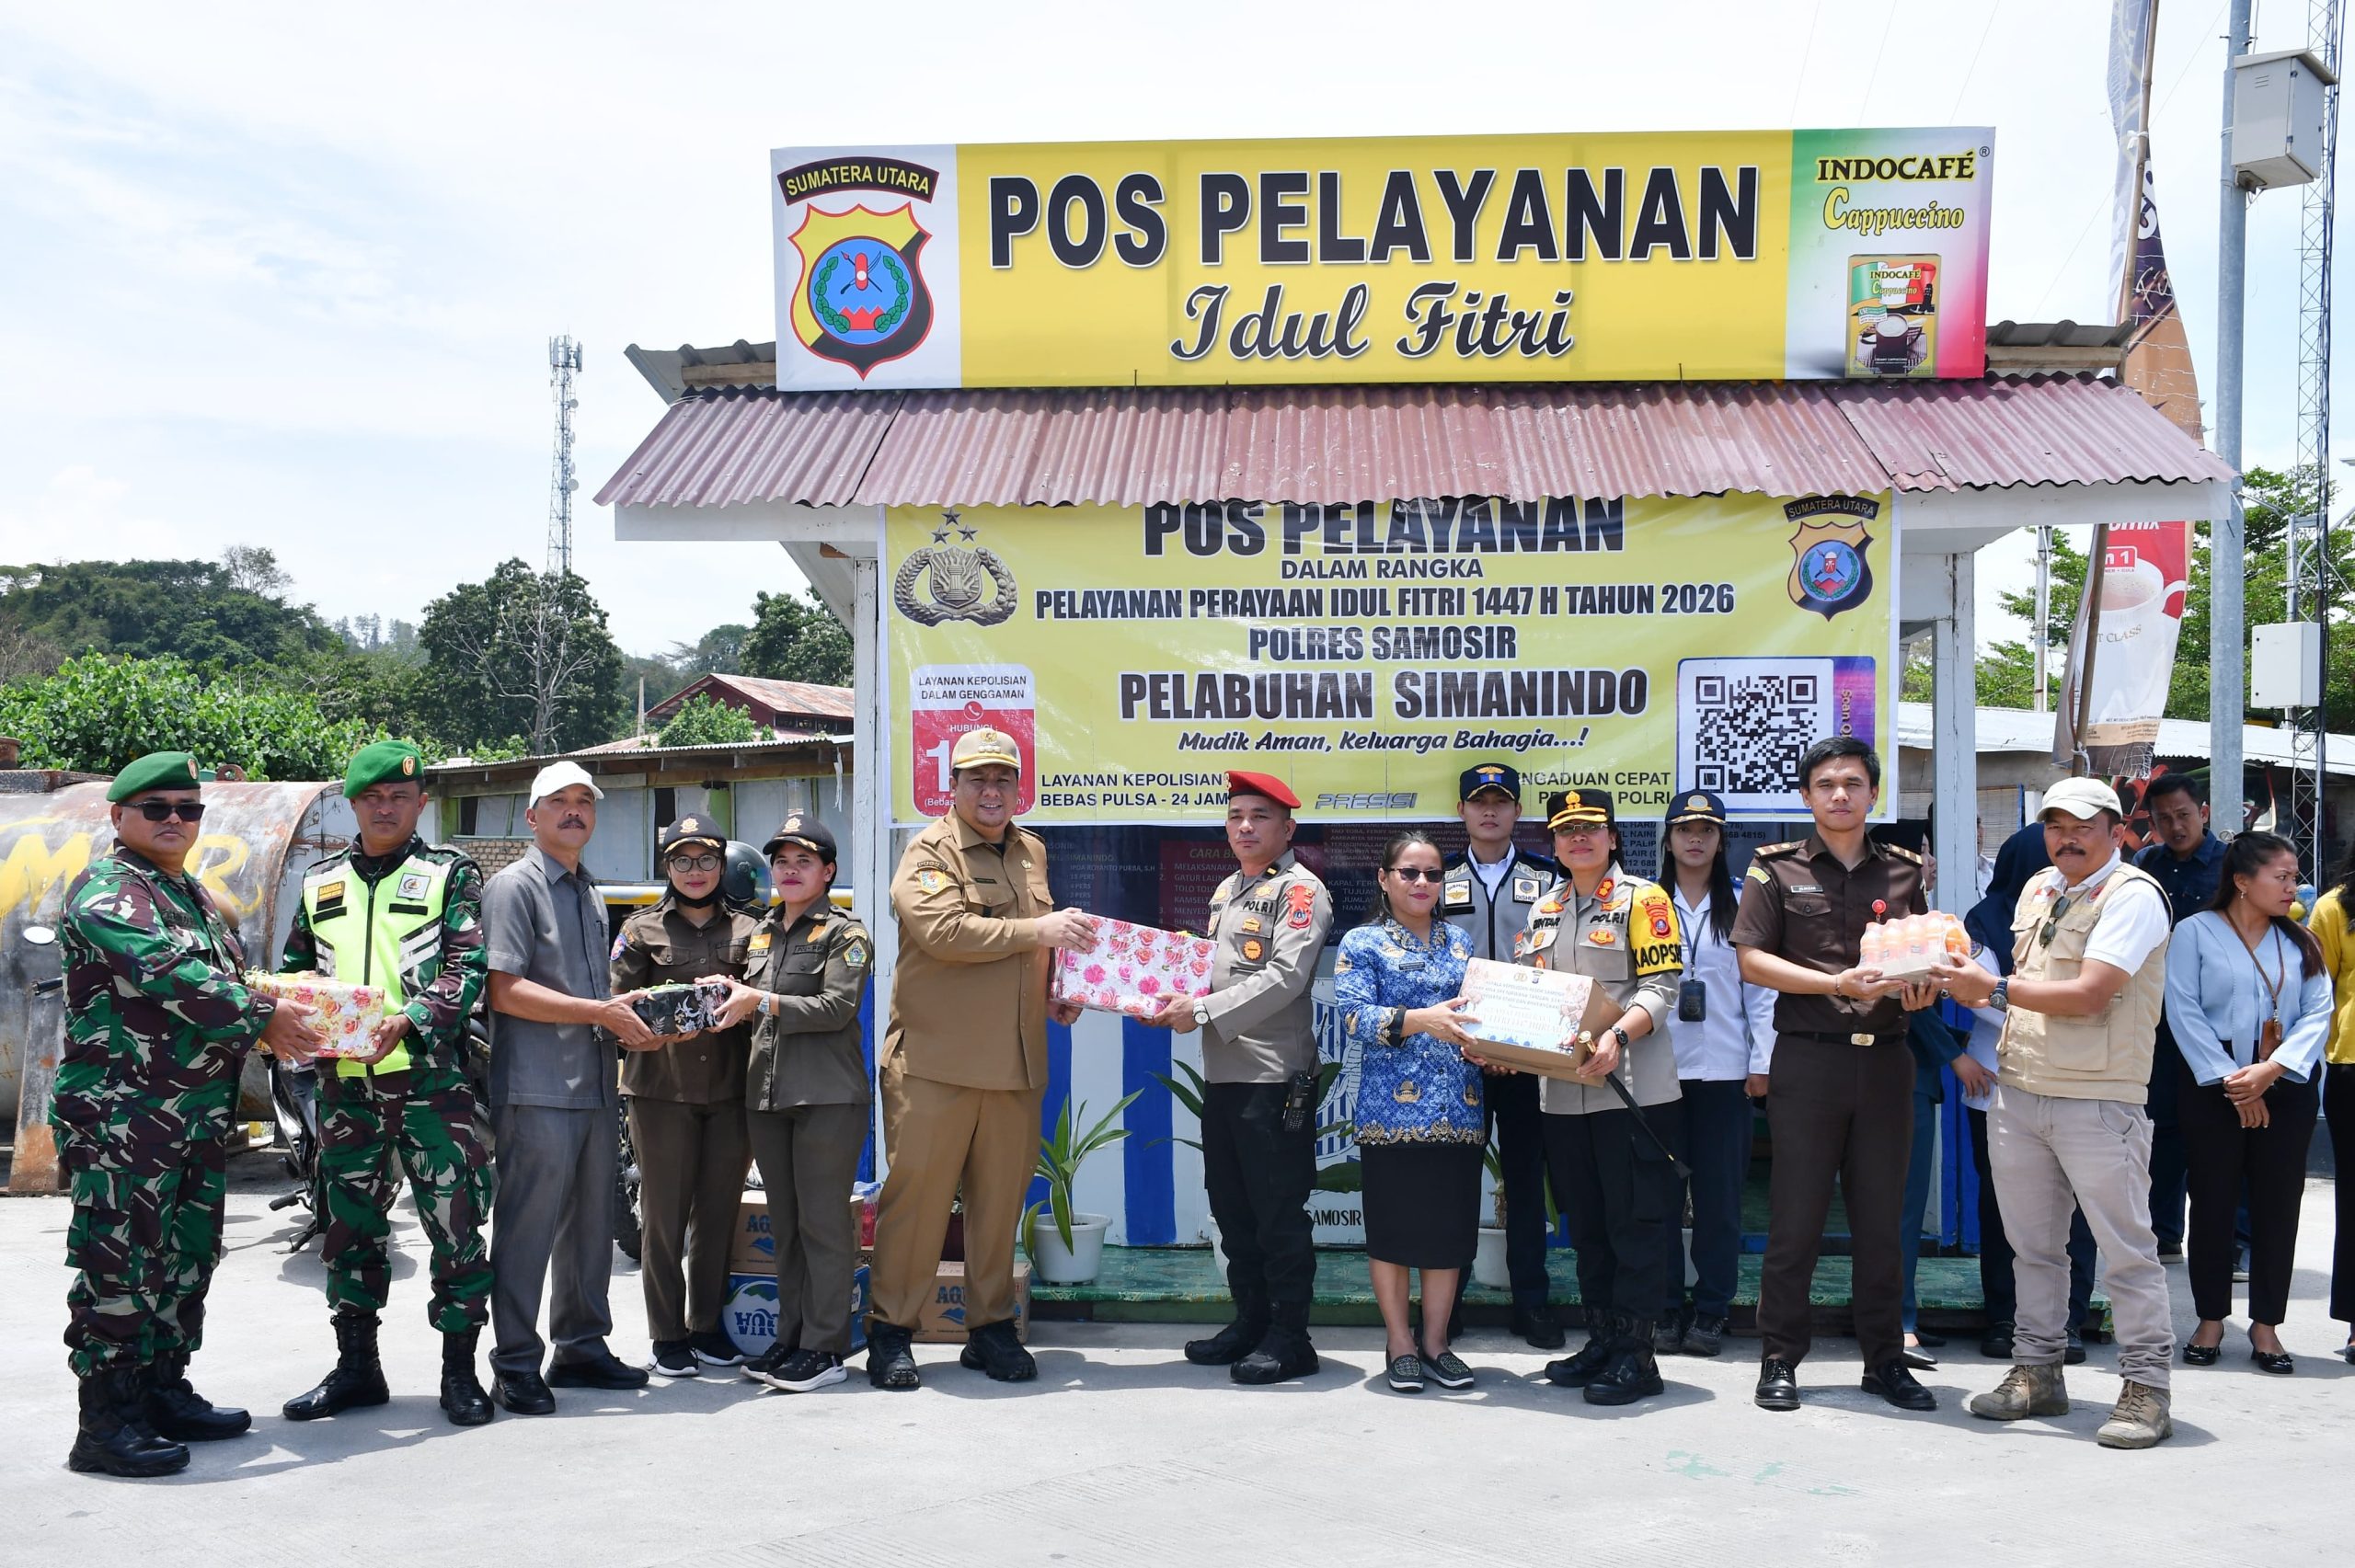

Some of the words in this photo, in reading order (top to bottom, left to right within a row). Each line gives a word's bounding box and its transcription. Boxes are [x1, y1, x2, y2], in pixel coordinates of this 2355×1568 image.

[1816, 151, 1975, 181] INDOCAFÉ
[786, 165, 874, 197] SUMATERA
[877, 166, 931, 195] UTARA
[988, 171, 1168, 269] POS
[1199, 166, 1759, 266] PELAYANAN
[1822, 187, 1965, 237] Cappuccino
[1170, 283, 1370, 361] Idul
[1395, 280, 1574, 360] Fitri
[1787, 498, 1841, 519] SUMATERA
[1843, 499, 1875, 517] UTARA
[1143, 499, 1267, 557] POS
[1281, 497, 1625, 555] PELAYANAN
[1281, 558, 1368, 580] DALAM
[1375, 557, 1484, 579] RANGKA
[1035, 589, 1184, 621] PELAYANAN
[1189, 587, 1325, 619] PERAYAAN
[1329, 586, 1394, 618] IDUL
[1397, 585, 1466, 618] FITRI
[1471, 584, 1534, 617] 1447
[1539, 584, 1560, 616] H
[1565, 583, 1656, 616] TAHUN
[1660, 582, 1736, 615] 2026
[1249, 625, 1365, 662] POLRES
[1370, 624, 1518, 660] SAMOSIR
[2107, 624, 2142, 643] CLASS
[919, 676, 964, 686] LAYANAN
[967, 676, 1027, 686] KEPOLISIAN
[921, 690, 957, 700] DALAM
[959, 690, 1025, 700] GENGGAMAN
[1119, 670, 1374, 722] PELABUHAN
[1395, 668, 1648, 719] SIMANINDO
[1178, 731, 1249, 752] Mudik
[1254, 731, 1333, 754] Aman,
[1338, 730, 1448, 753] Keluarga
[1453, 727, 1590, 755] Bahagia...!
[1041, 773, 1119, 788] LAYANAN
[1122, 771, 1223, 788] KEPOLISIAN
[1518, 773, 1609, 785] NGADUAN
[1614, 771, 1671, 786] CEPAT
[1040, 791, 1097, 807] BEBAS
[1101, 791, 1156, 807] PULSA
[1171, 790, 1189, 806] 24
[1192, 790, 1229, 807] JAM
[1315, 792, 1418, 810] PRESISI
[1617, 790, 1671, 806] POLRI
[1174, 907, 1210, 915] MENYEDI
[1242, 900, 1275, 914] POLRI
[1590, 911, 1626, 925] POLRI
[746, 1214, 773, 1235] AQ
[1309, 1209, 1361, 1227] AMOSIR
[935, 1286, 965, 1307] AQ
